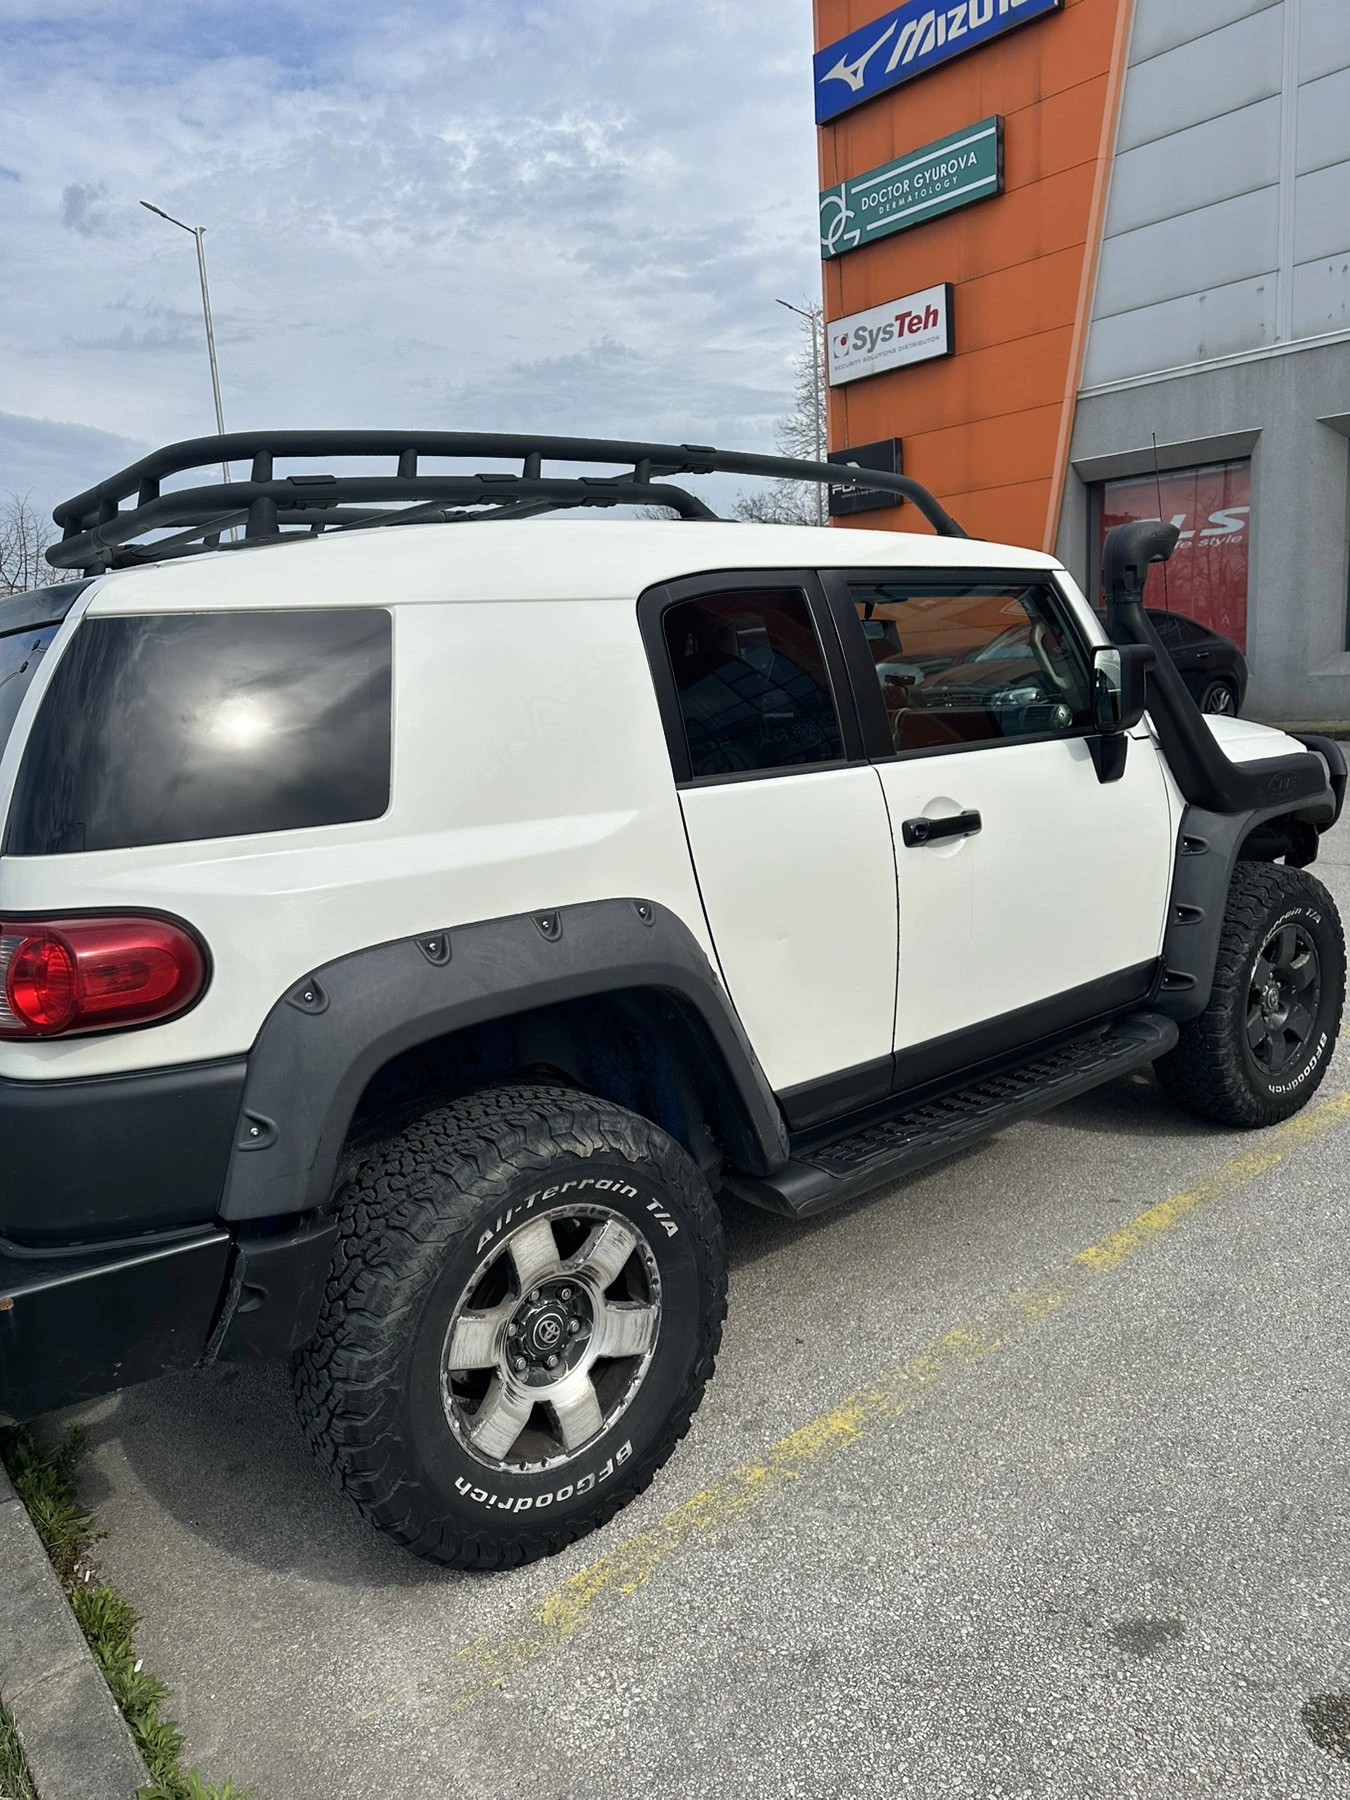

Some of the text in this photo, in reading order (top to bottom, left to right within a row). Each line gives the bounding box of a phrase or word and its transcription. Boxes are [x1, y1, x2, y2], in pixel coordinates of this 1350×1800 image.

[861, 151, 978, 211] DOCTOR GYUROVA
[878, 176, 959, 214] DERMATOLOGY
[834, 335, 941, 372] SECURITY SOLUTIONS DISTRIBUTOR
[852, 304, 939, 354] SysTeh
[1198, 534, 1243, 548] style
[1268, 1032, 1328, 1094] BFGoodrich
[476, 1178, 638, 1255] All-Terrain
[454, 1439, 634, 1514] BFGoodrich
